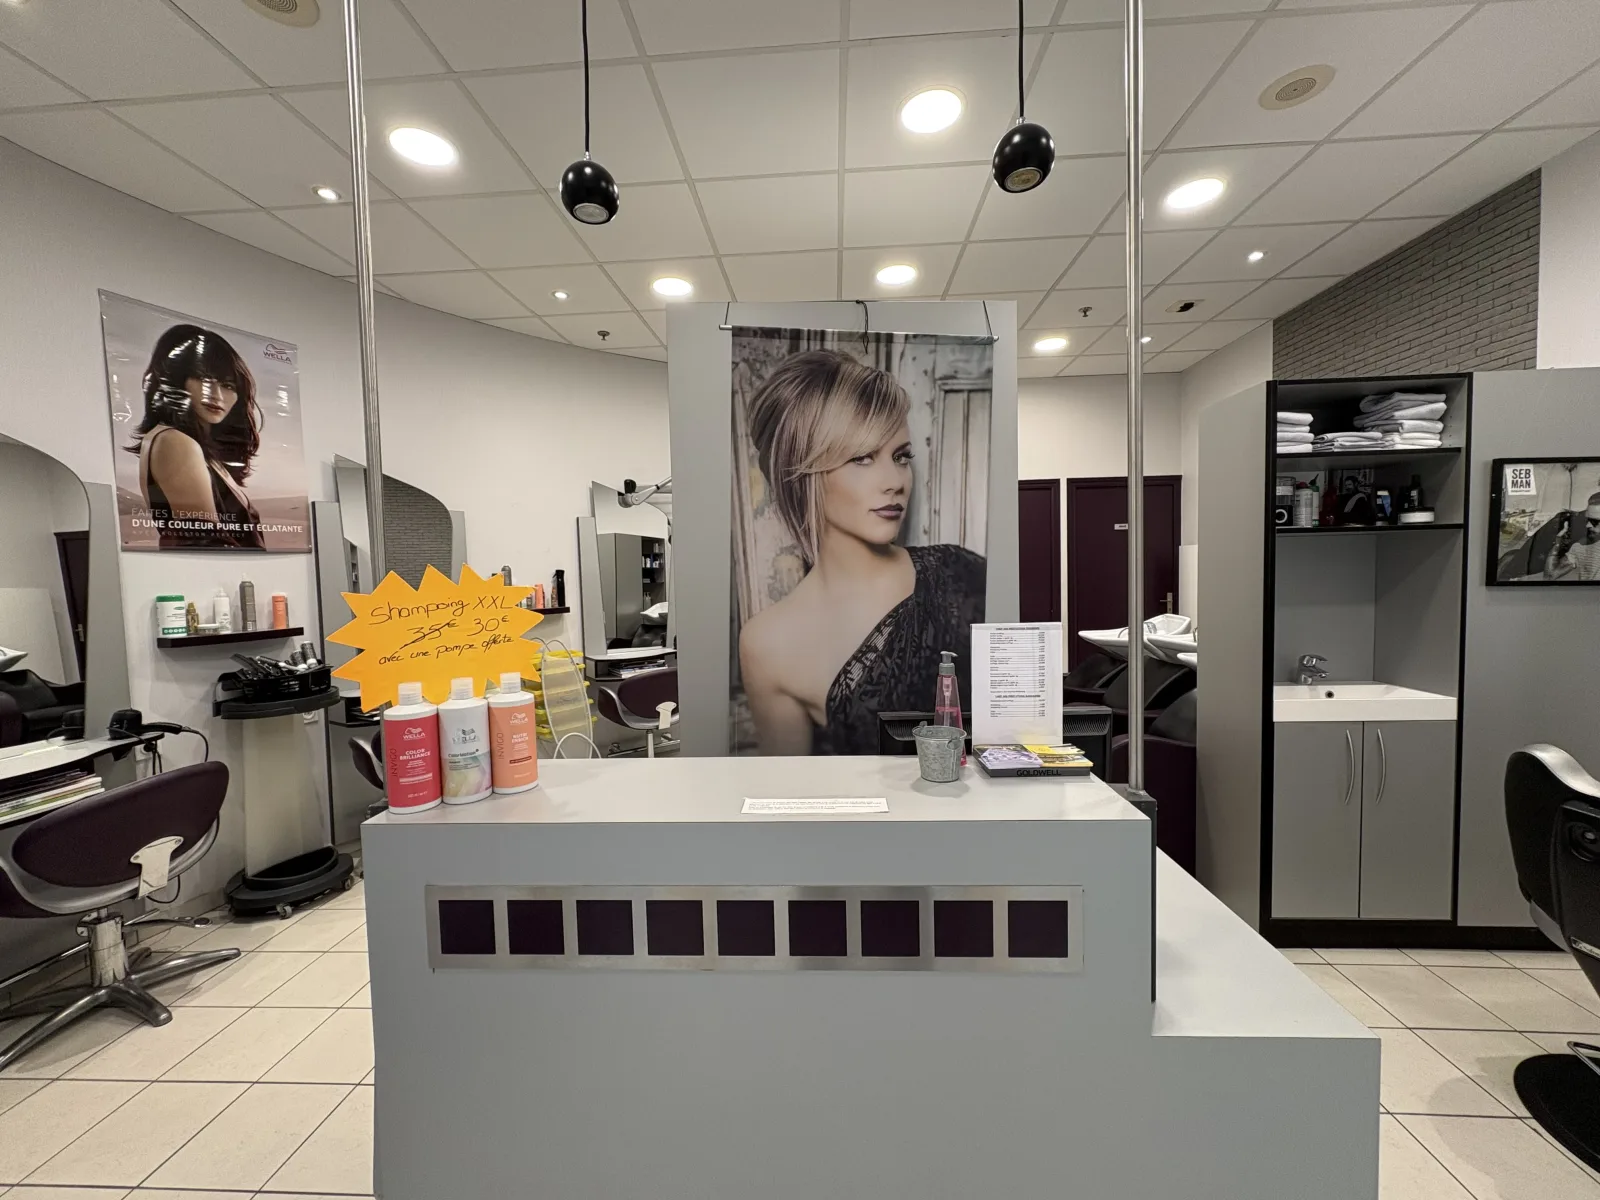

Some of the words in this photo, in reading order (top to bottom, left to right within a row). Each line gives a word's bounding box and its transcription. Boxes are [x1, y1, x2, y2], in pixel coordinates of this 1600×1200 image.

[263, 350, 291, 362] WELLA
[1512, 469, 1531, 479] SEB
[1511, 480, 1531, 488] MAN
[131, 508, 168, 518] FAITES
[172, 509, 237, 521] L'EXPÉRIENCE
[132, 519, 165, 528] D'UNE
[168, 521, 214, 530] COULEUR
[217, 523, 241, 531] PURE
[256, 523, 302, 532] ÉCLATANTE
[472, 595, 514, 610] XXL
[466, 614, 510, 637] 30€
[378, 651, 404, 665] avec
[410, 650, 431, 659] une
[435, 643, 478, 659] pompe
[400, 751, 431, 760] BRILLIANCE
